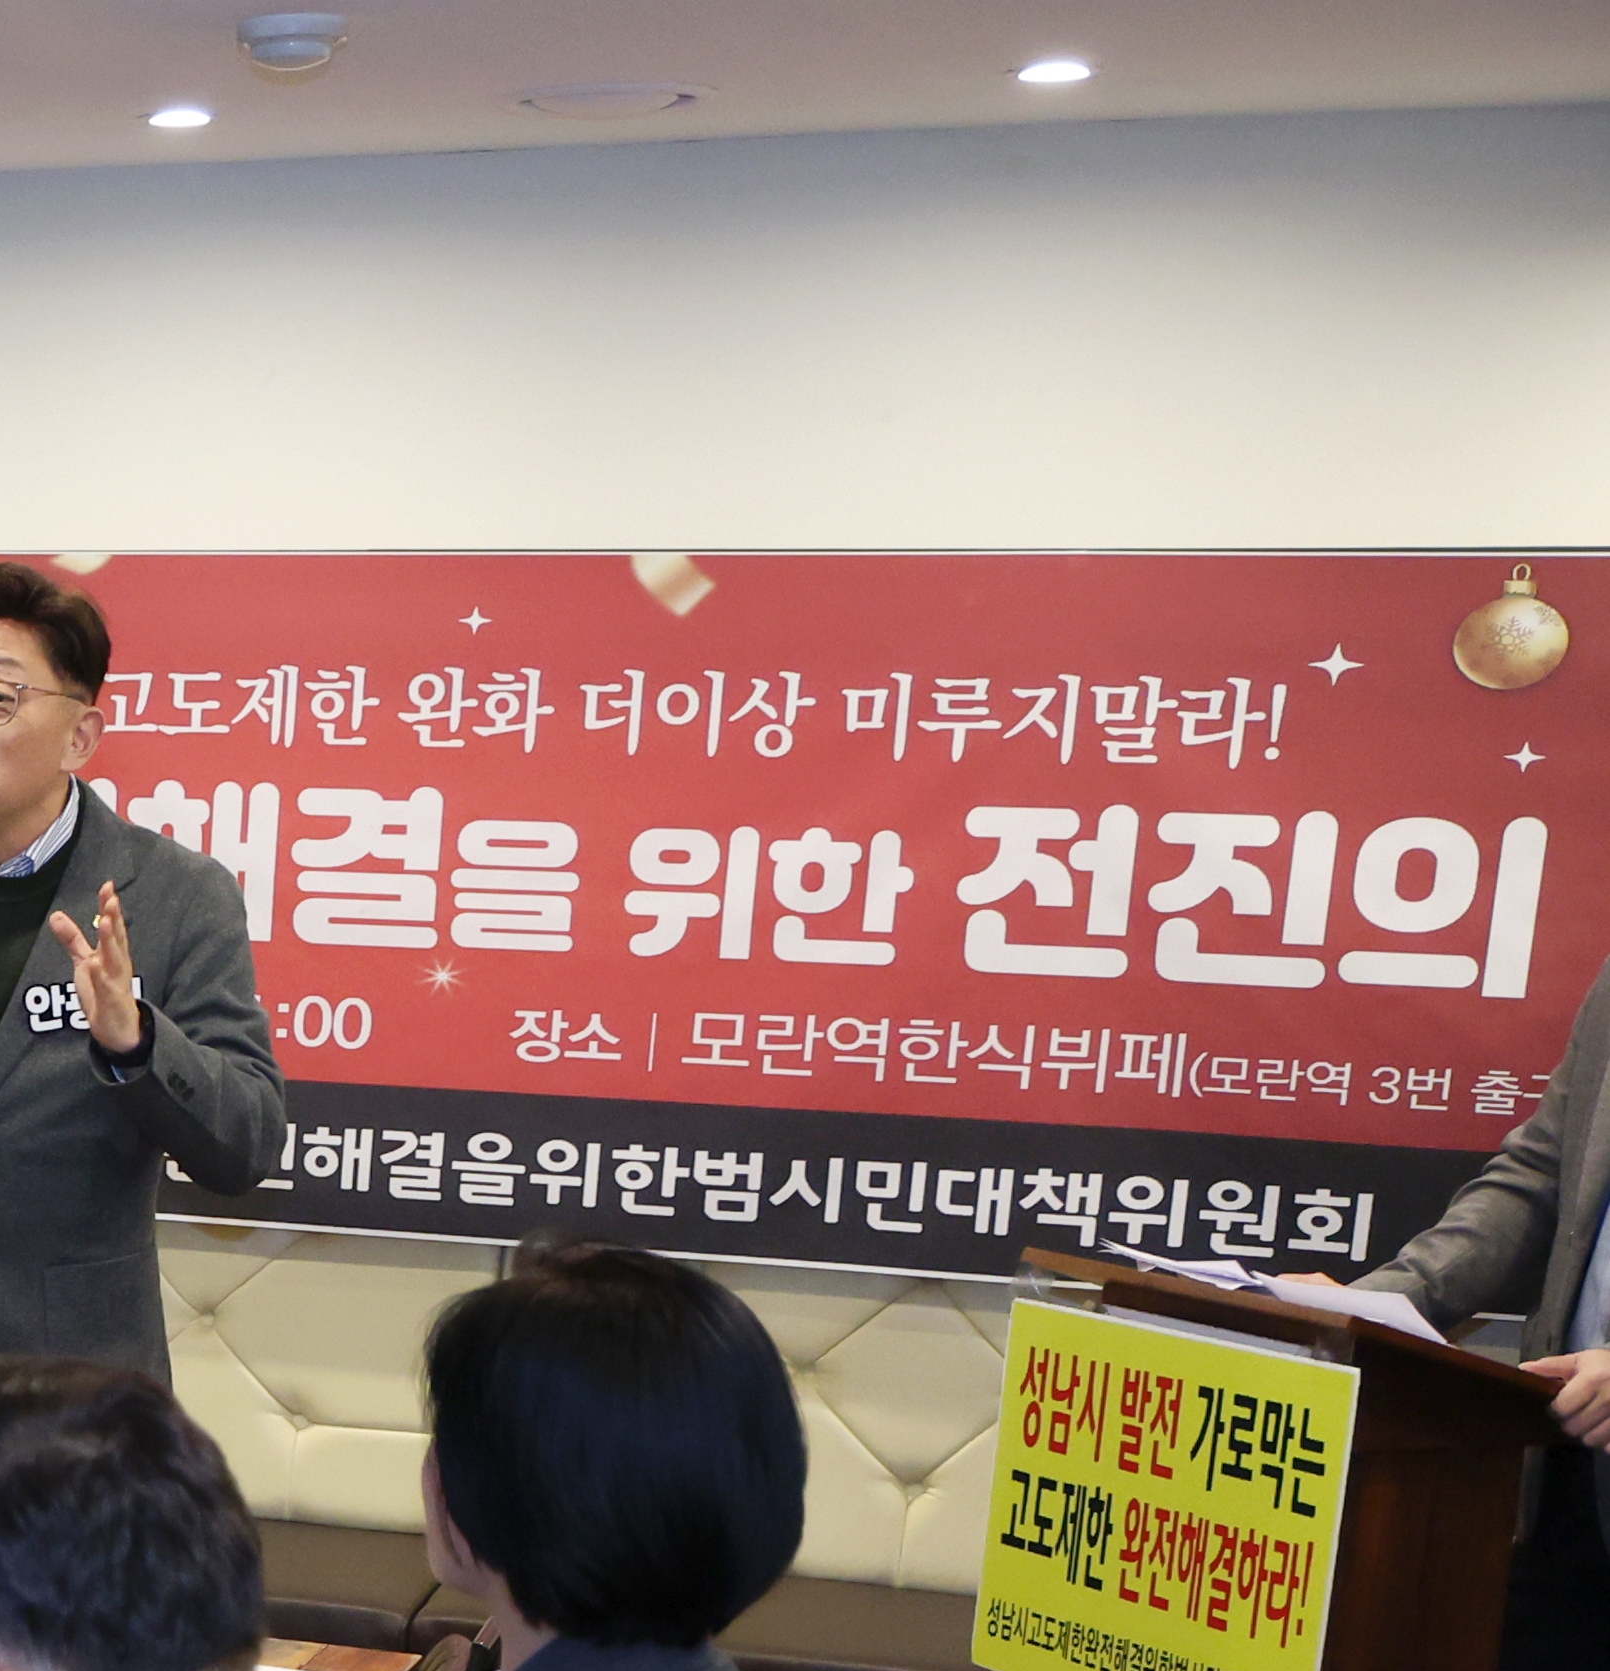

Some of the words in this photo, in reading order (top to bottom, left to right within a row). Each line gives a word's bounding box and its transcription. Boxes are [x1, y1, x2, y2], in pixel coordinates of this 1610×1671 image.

[103, 664, 380, 749] 고도제한
[397, 665, 555, 754] 완화
[579, 668, 816, 759] 더이상
[841, 672, 1288, 770] 미루지말라!
[623, 825, 915, 966] 위한
[956, 803, 1549, 1000] 전진의
[509, 1008, 623, 1064] 장소
[1368, 1066, 1453, 1112] 3번
[1019, 1345, 1111, 1463] 성남시
[1117, 1366, 1184, 1480] 발전
[1189, 1384, 1326, 1519] 가로막는
[1000, 1469, 1113, 1592] 고도제한
[1117, 1497, 1314, 1649] 완전해결하라!
